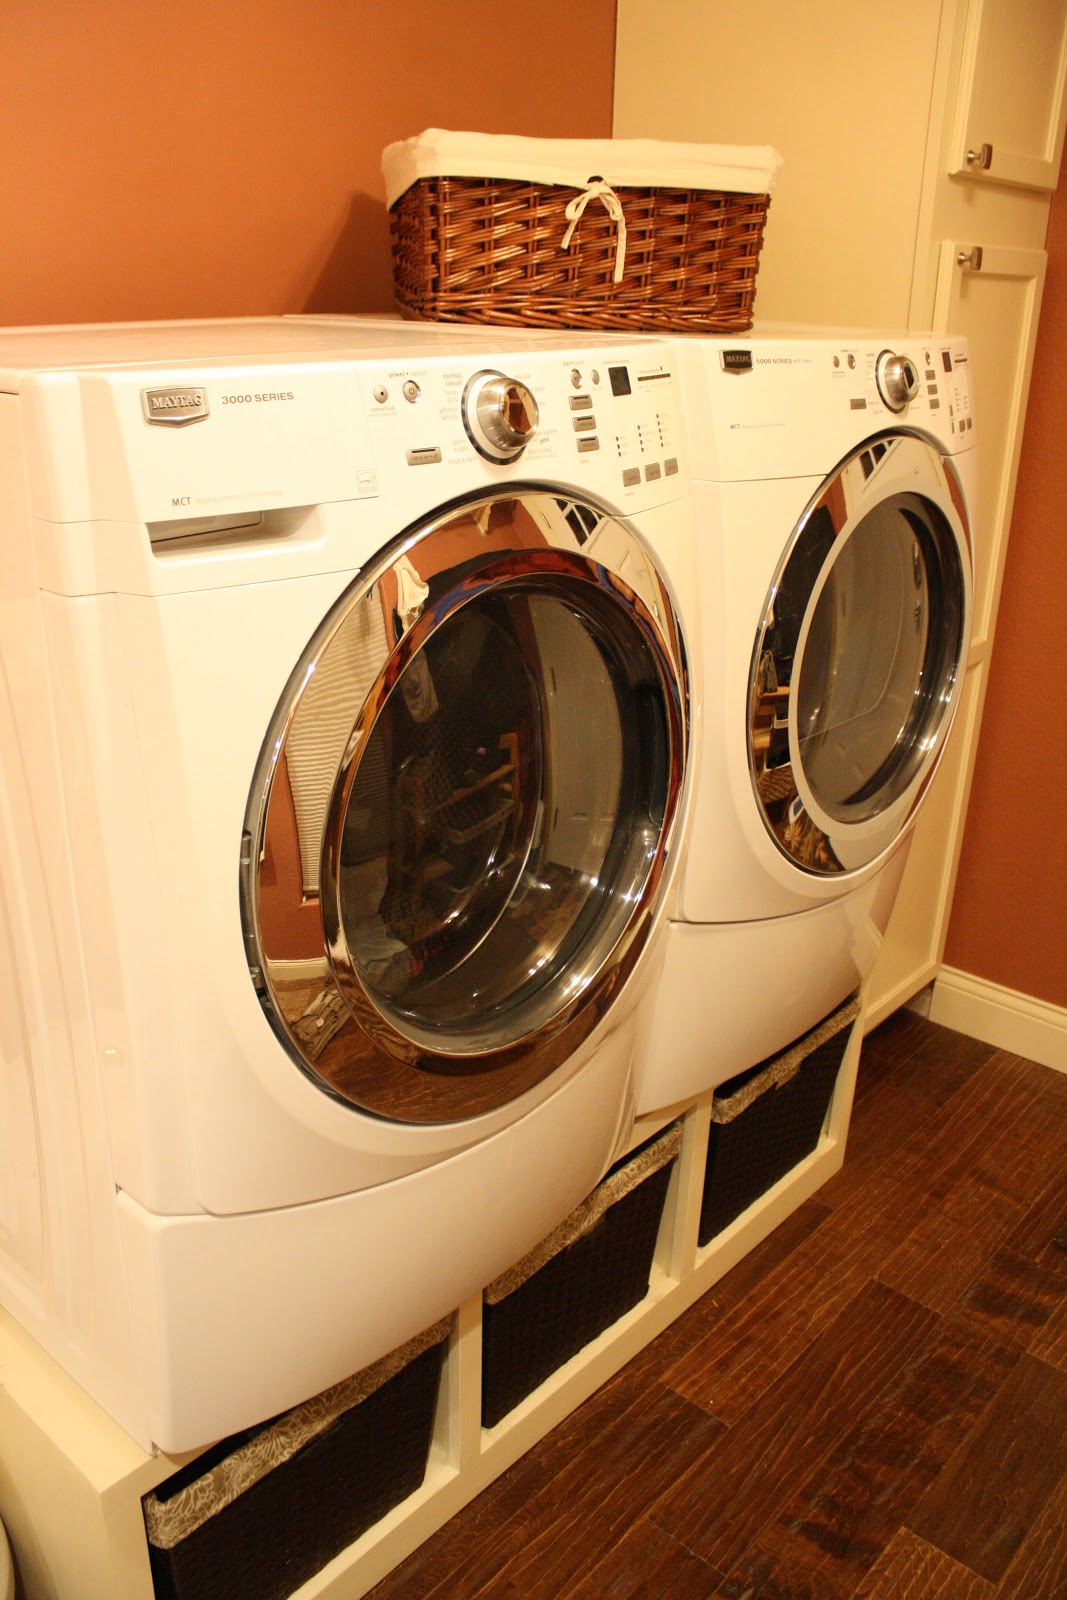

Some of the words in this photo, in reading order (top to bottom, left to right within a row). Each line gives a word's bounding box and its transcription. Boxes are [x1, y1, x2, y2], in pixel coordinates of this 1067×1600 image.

[725, 355, 751, 363] MAYTAG
[388, 371, 405, 379] power
[151, 394, 202, 411] MAYTAG
[221, 394, 252, 405] 3000
[254, 391, 294, 403] SERIES
[171, 496, 191, 507] MCT
